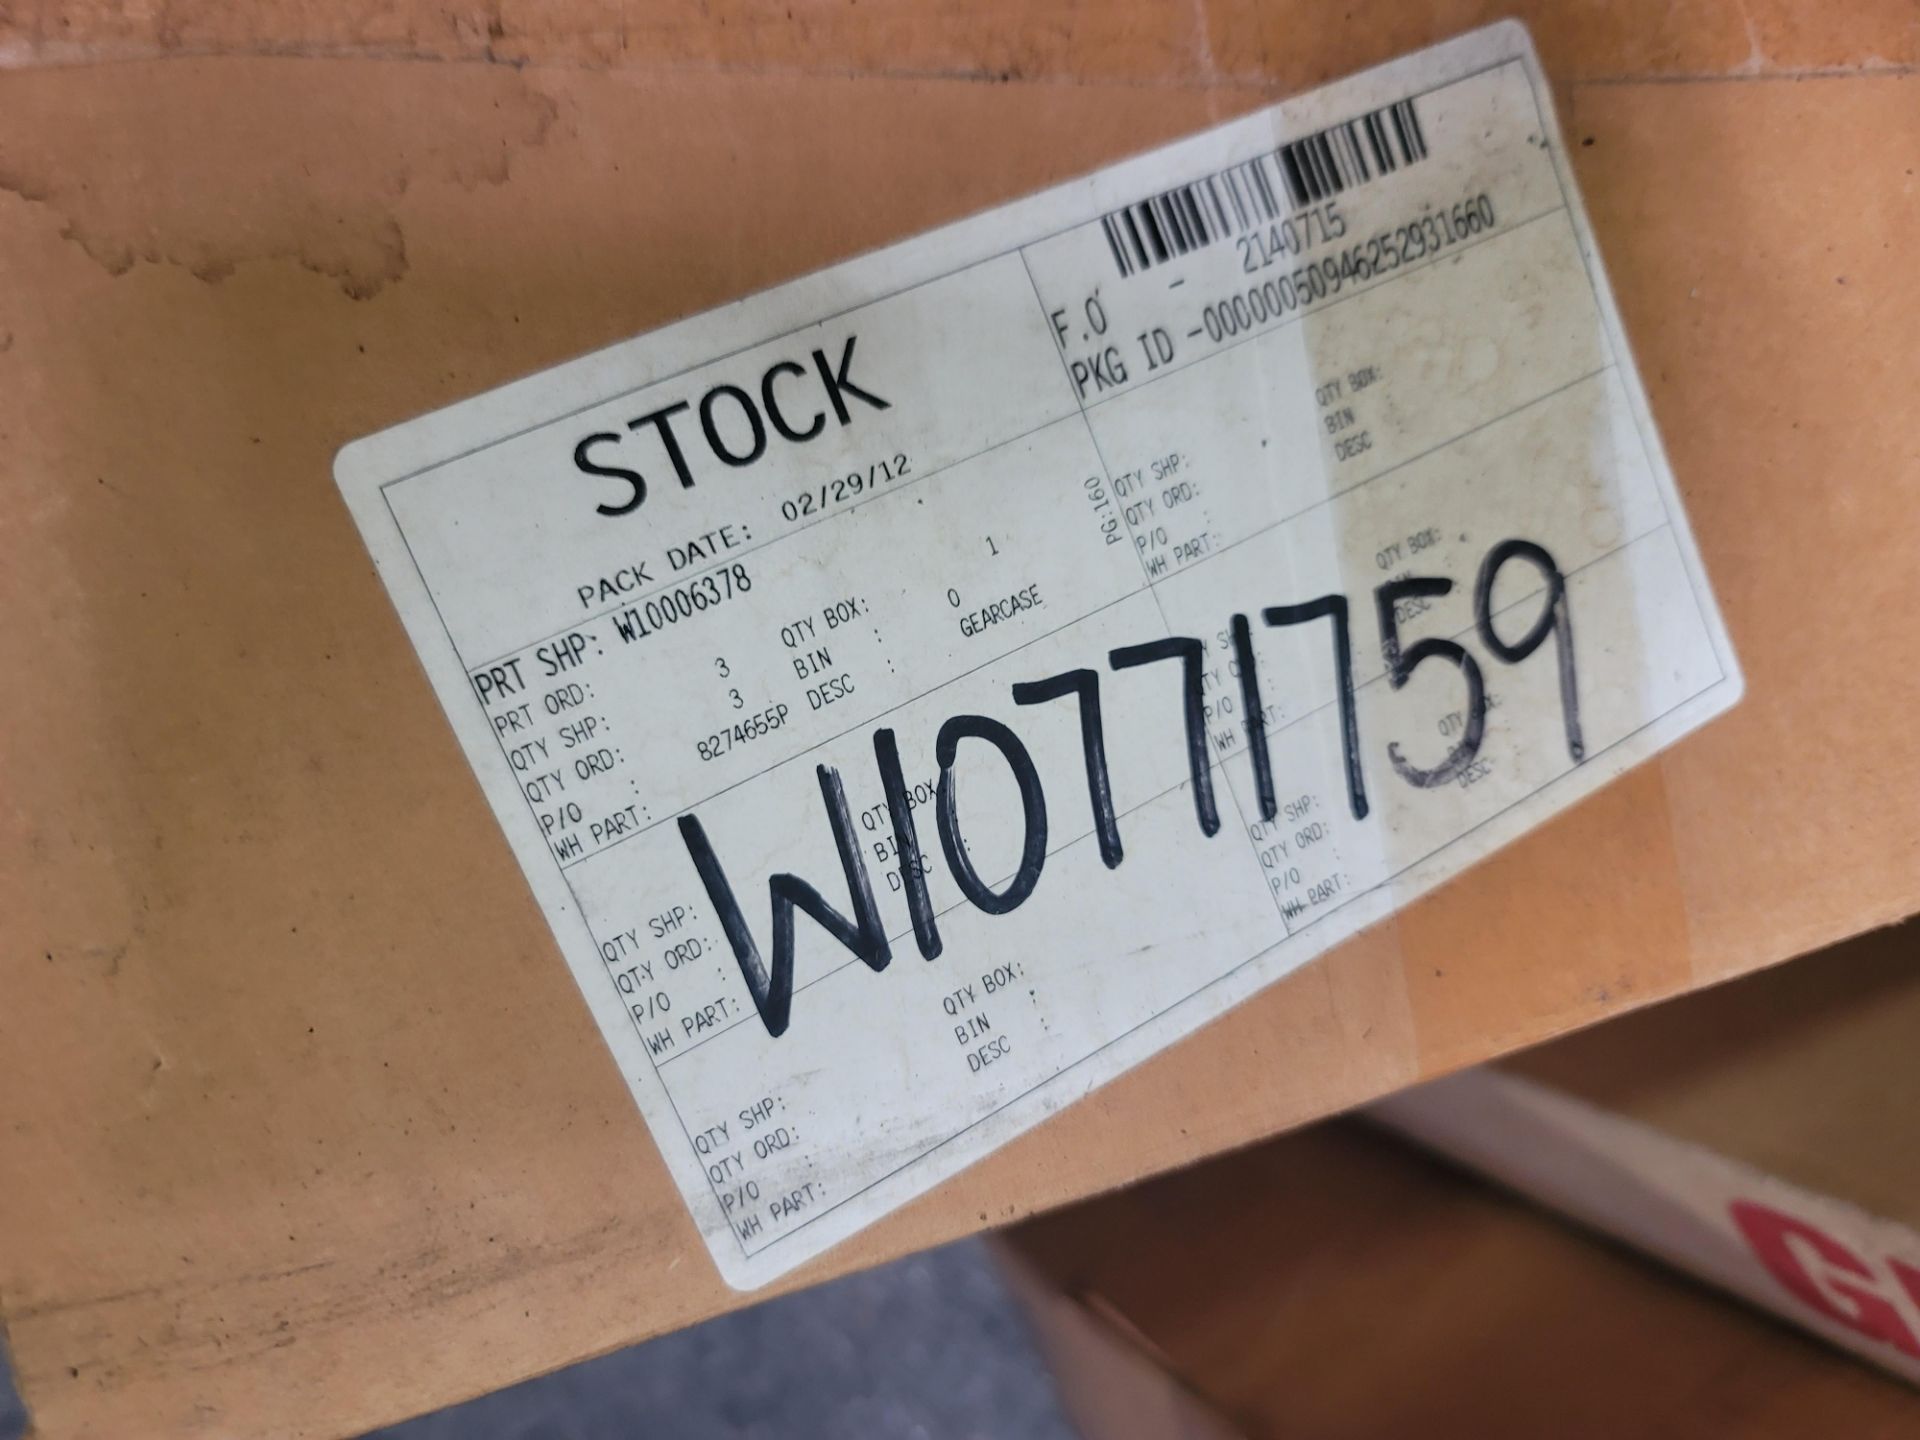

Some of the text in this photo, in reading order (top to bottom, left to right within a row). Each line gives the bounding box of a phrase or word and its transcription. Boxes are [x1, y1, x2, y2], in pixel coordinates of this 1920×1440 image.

[1236, 201, 1347, 274] 2140715
[1070, 345, 1128, 399] PKG
[1137, 327, 1174, 370] ID
[1314, 378, 1341, 406] QTY
[573, 336, 891, 516] STOCK
[1323, 407, 1355, 434] BIN
[1333, 429, 1372, 462] DESC
[1113, 452, 1189, 496] QTY SHP:
[577, 453, 910, 608] PACK DATE: 02/29/12
[1083, 476, 1122, 545] PG:160
[1125, 481, 1200, 525] QTY ORD:
[1135, 526, 1167, 554] P/O
[1145, 531, 1219, 577] WH PART:
[780, 536, 998, 647] QTY BOX: 1
[473, 563, 751, 704] PRT SHP: W10006378
[805, 673, 854, 710] DESC
[959, 583, 1042, 637] GEARCASE
[792, 646, 832, 679] BIN
[493, 682, 594, 737] PRT ORD:
[510, 657, 729, 770] QTY SHP: 3
[526, 688, 743, 802] QTY ORD: 3
[1214, 731, 1234, 750] WH
[540, 802, 582, 835] P/O
[697, 703, 787, 760] 8274655P
[553, 804, 651, 861] WH PART:
[1260, 821, 1329, 868] QTY ORD:
[1271, 867, 1300, 895] P/O
[602, 905, 696, 962] QTY SHP:
[617, 937, 711, 993] QTY ORD:
[942, 961, 1024, 1015] QTY BOX:
[631, 991, 670, 1024] P/O
[646, 996, 739, 1055] WH PART:
[954, 1012, 990, 1045] BIN
[966, 1034, 1010, 1072] DESC
[694, 1096, 785, 1154] QTY SHP:
[709, 1126, 799, 1183] QTY ORD:
[722, 1180, 759, 1214] P/O
[736, 1181, 826, 1240] WH PART:
